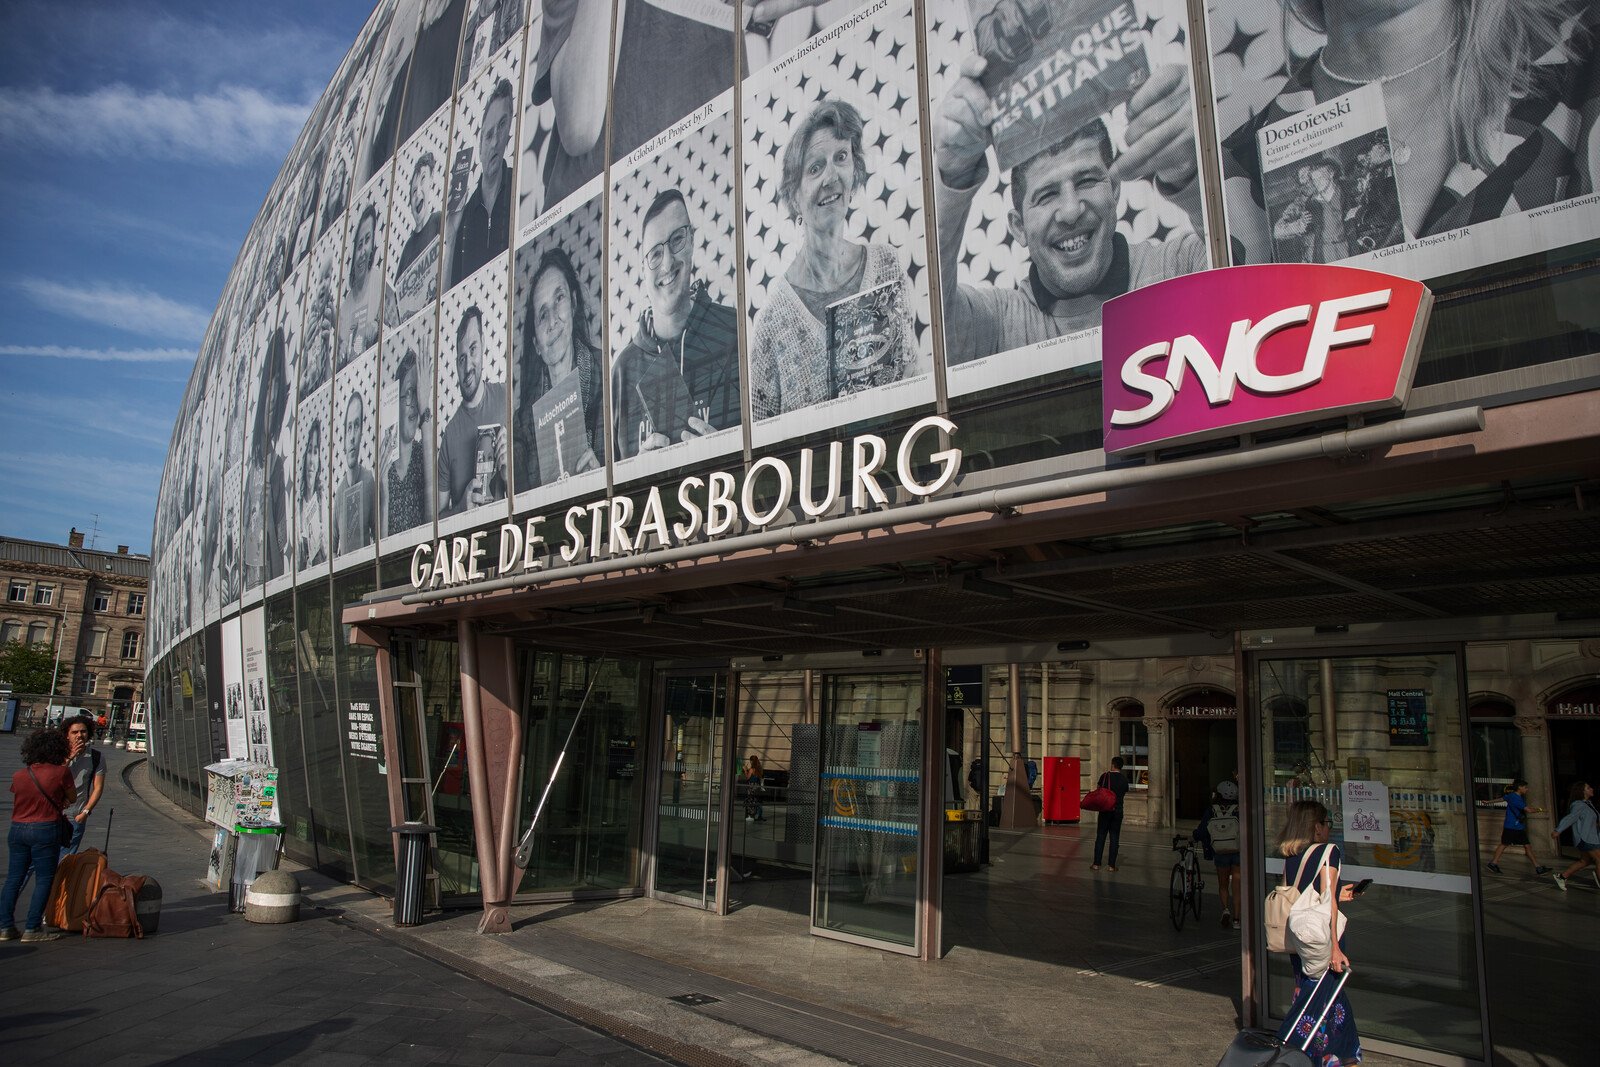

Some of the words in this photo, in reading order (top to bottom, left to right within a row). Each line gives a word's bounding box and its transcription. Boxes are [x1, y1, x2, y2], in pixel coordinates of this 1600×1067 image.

[773, 0, 888, 74] www.insideoutproject.net
[991, 3, 1133, 118] L'ATTAQUE
[991, 105, 1022, 137] DES
[1022, 23, 1147, 120] TITANS
[627, 156, 632, 167] A
[634, 140, 655, 162] Global
[656, 136, 667, 148] Art
[668, 119, 692, 140] Project
[693, 113, 702, 125] by
[703, 103, 714, 120] JR
[1265, 98, 1351, 145] Dostoïevski
[1266, 142, 1291, 157] Crime
[1292, 138, 1301, 147] et
[1302, 121, 1344, 143] châtiment
[1372, 252, 1379, 261] A
[1380, 244, 1404, 258] Global
[1406, 242, 1418, 252] Art
[1419, 235, 1446, 249] Project
[1447, 232, 1458, 243] by
[1459, 228, 1470, 239] JR
[1110, 288, 1392, 425] SNCF
[538, 391, 577, 429] Autochtones
[411, 531, 487, 588] GARE
[499, 516, 546, 574] DE
[560, 416, 963, 563] STRASBOURG
[1177, 706, 1199, 716] Hall
[1348, 782, 1364, 790] Pied
